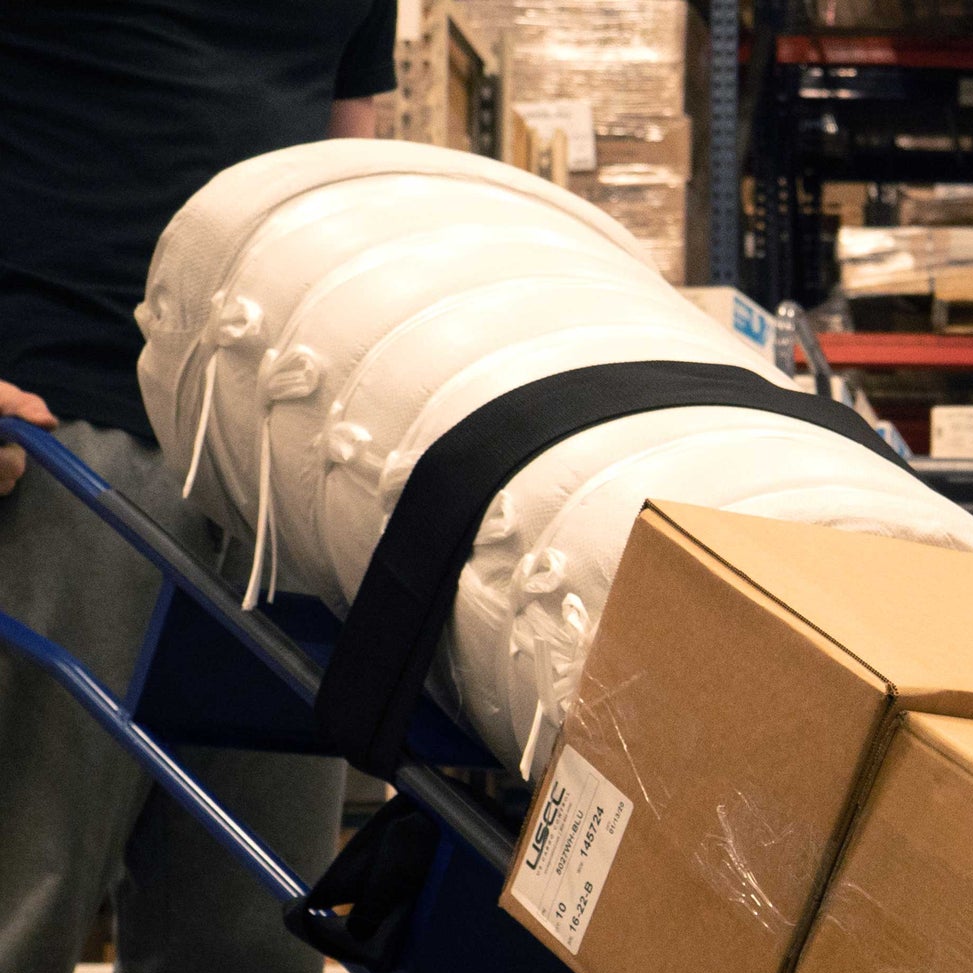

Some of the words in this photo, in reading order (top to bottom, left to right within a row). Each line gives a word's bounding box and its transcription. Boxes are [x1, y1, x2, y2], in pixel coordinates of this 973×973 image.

[579, 806, 605, 857] 145724
[555, 902, 567, 920] 10
[568, 881, 594, 933] 16-22-B
